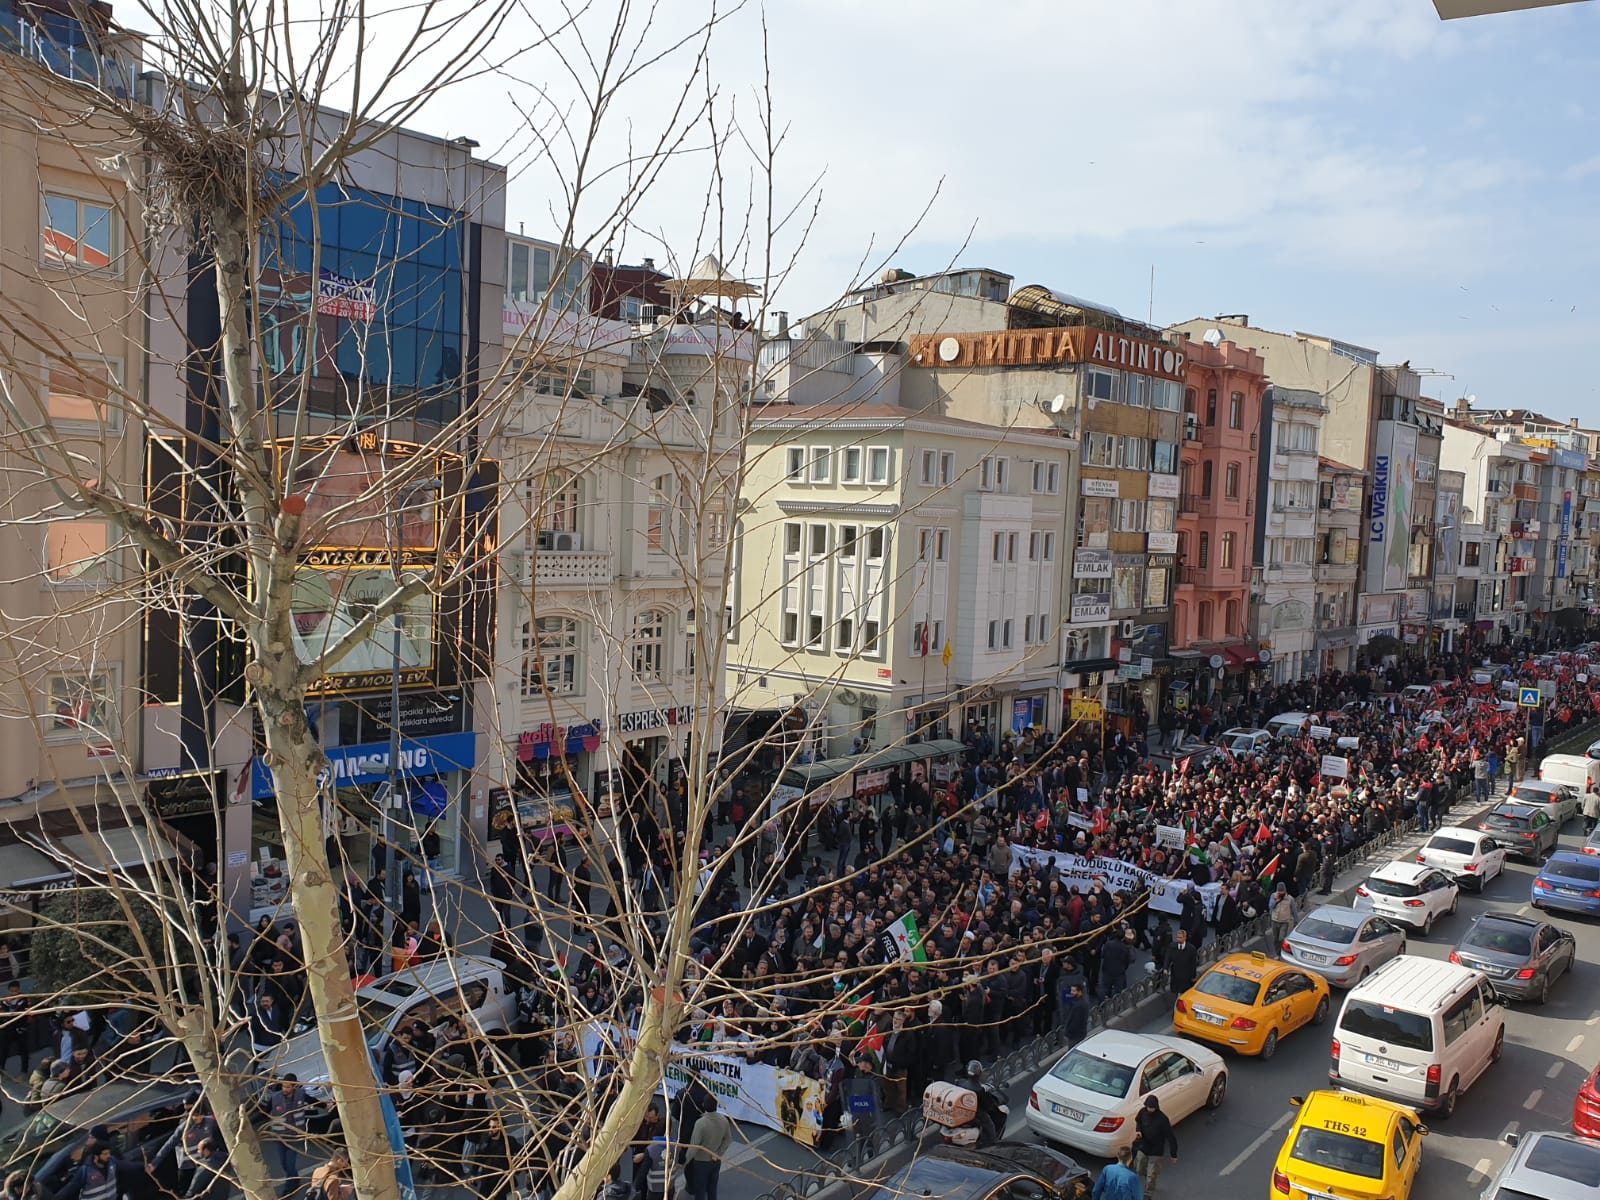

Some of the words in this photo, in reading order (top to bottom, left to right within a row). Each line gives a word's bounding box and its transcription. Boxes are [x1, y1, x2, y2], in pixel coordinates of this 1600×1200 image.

[1370, 521, 1384, 542] LC
[1076, 563, 1109, 573] EMLAK
[1074, 606, 1107, 617] EMLAK
[361, 673, 402, 687] MOD
[881, 934, 897, 958] FREE
[1323, 1119, 1351, 1133] THS
[1352, 1126, 1367, 1137] 42
